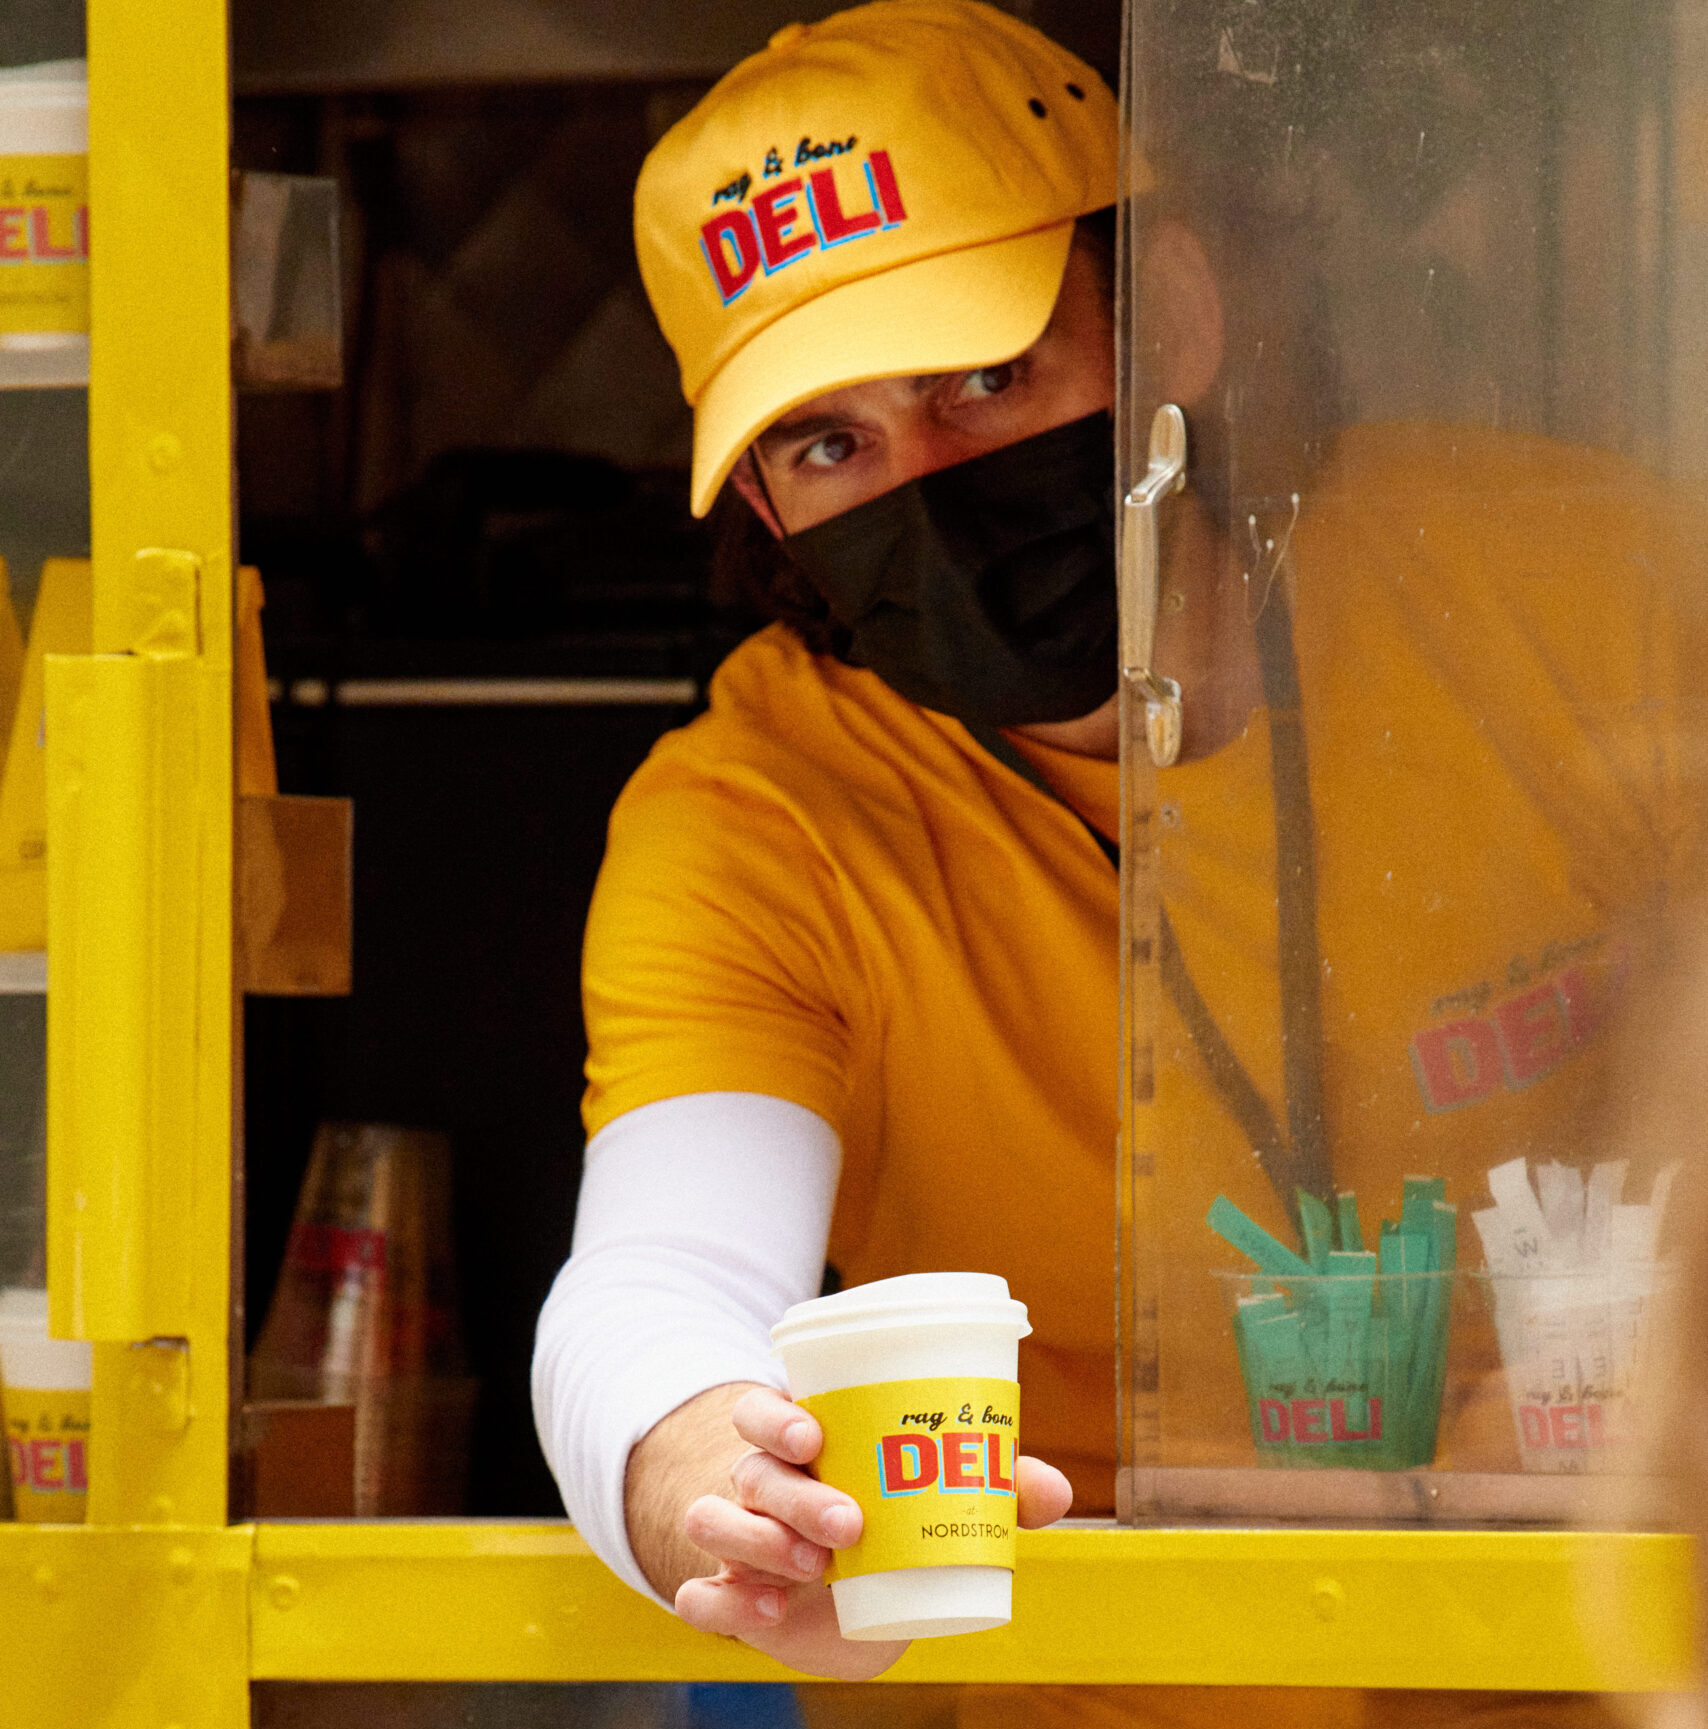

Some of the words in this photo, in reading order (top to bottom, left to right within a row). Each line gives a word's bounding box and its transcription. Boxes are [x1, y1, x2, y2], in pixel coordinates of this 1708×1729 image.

[762, 146, 783, 179] &
[699, 149, 908, 308] DELI
[900, 1411, 947, 1432] rag
[957, 1402, 973, 1425] &
[1258, 1397, 1383, 1446] DELI
[922, 1523, 1009, 1540] NORDSTROM
